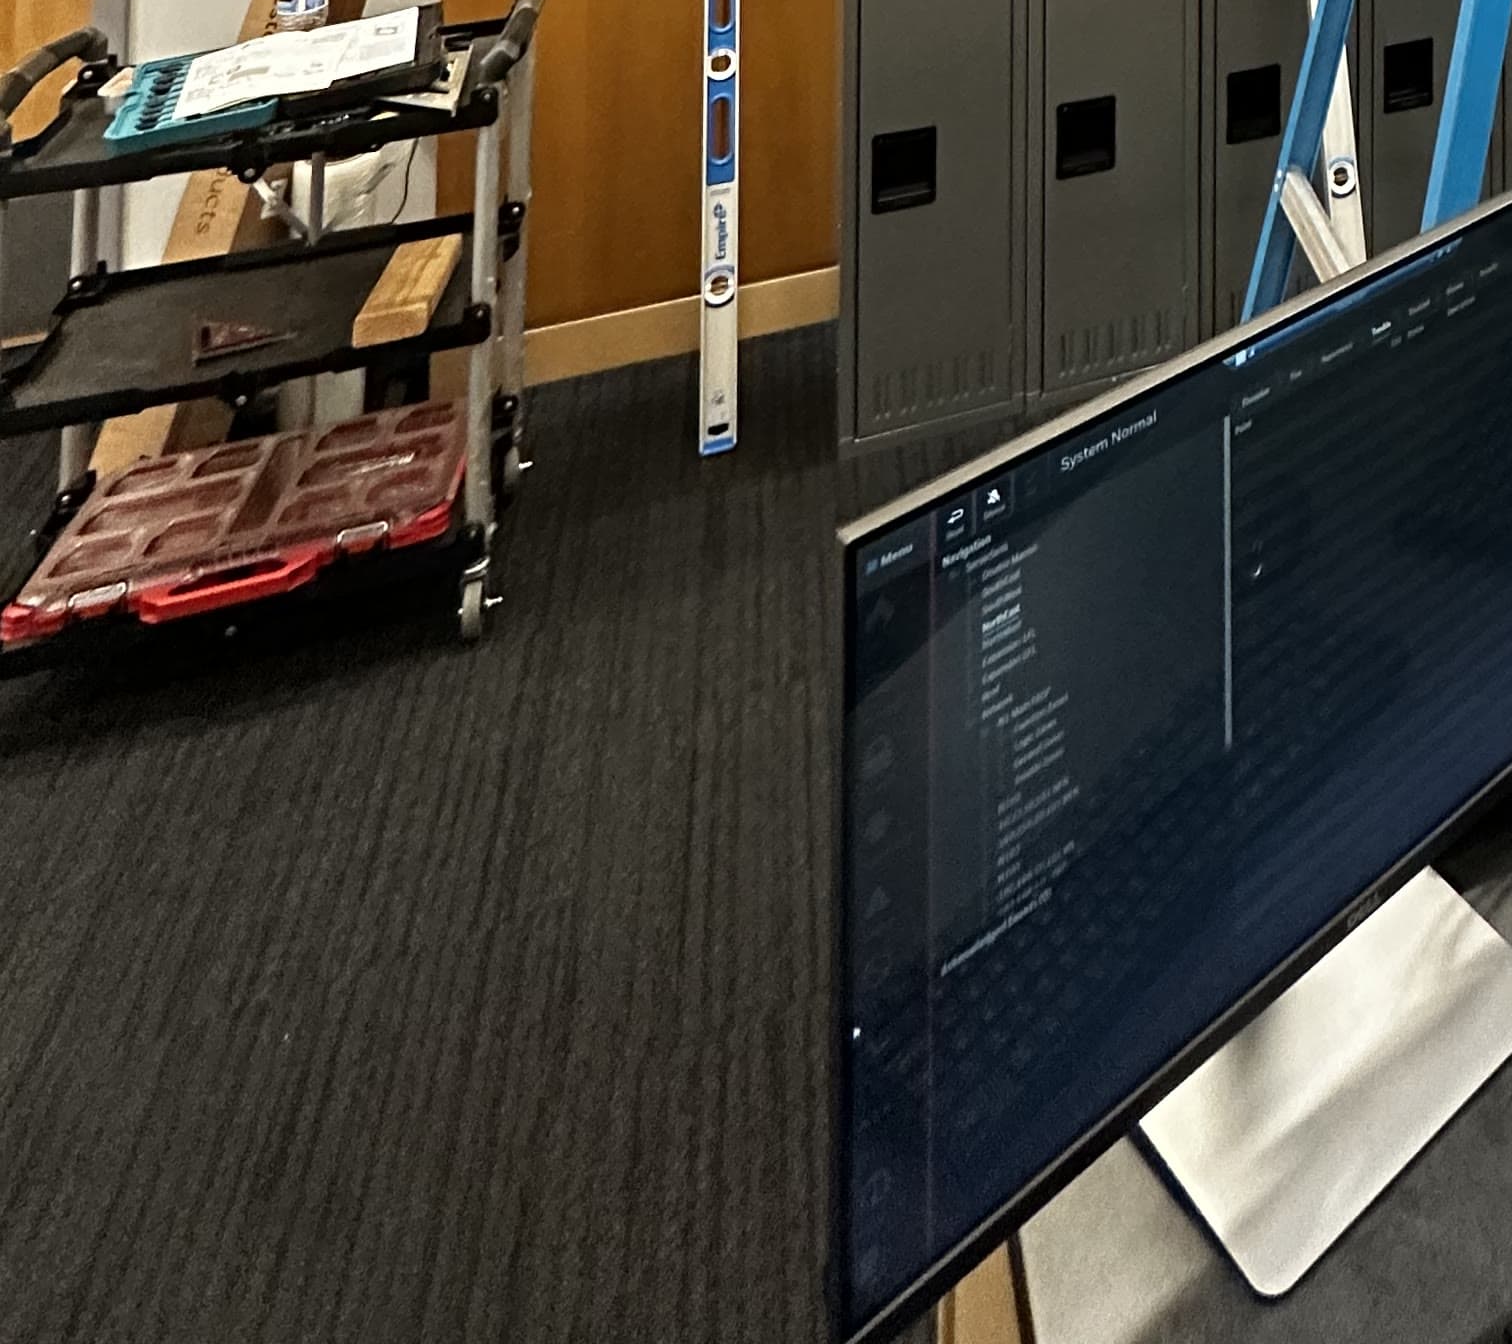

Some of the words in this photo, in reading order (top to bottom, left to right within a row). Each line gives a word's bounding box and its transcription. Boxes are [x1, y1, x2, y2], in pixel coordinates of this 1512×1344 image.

[1060, 438, 1109, 472] System
[1111, 408, 1158, 446] Normal
[880, 543, 914, 568] Menu
